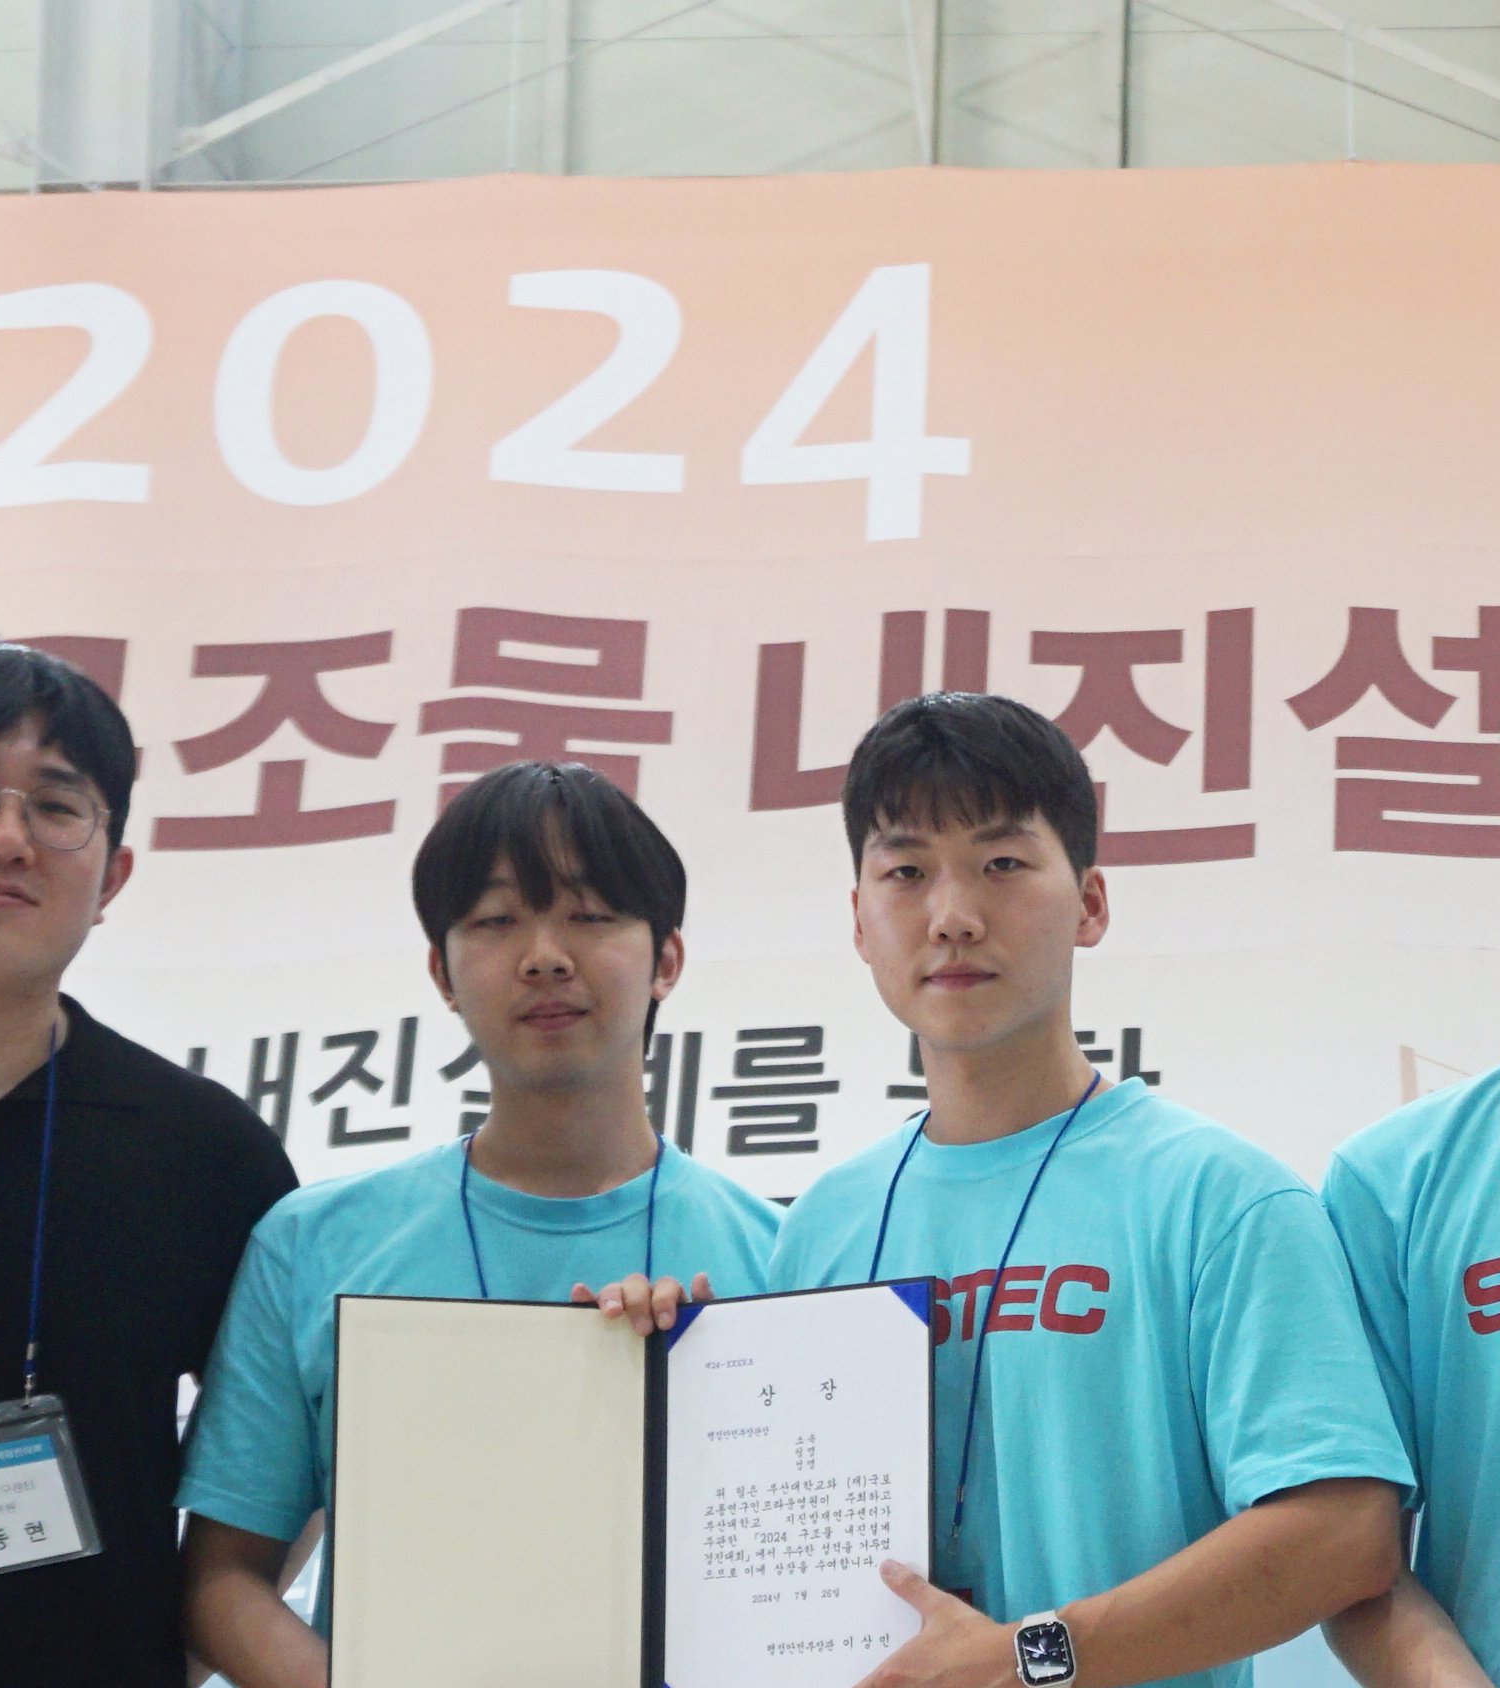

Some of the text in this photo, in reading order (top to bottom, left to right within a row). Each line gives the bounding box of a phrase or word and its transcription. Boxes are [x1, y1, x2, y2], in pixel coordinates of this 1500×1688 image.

[20, 606, 674, 851] 조물
[758, 1378, 837, 1407] 상 장
[769, 1477, 837, 1496] 부산대학교와
[704, 1506, 891, 1531] 부산대학교 지진방재연구센터가
[704, 1568, 738, 1580] 으므로
